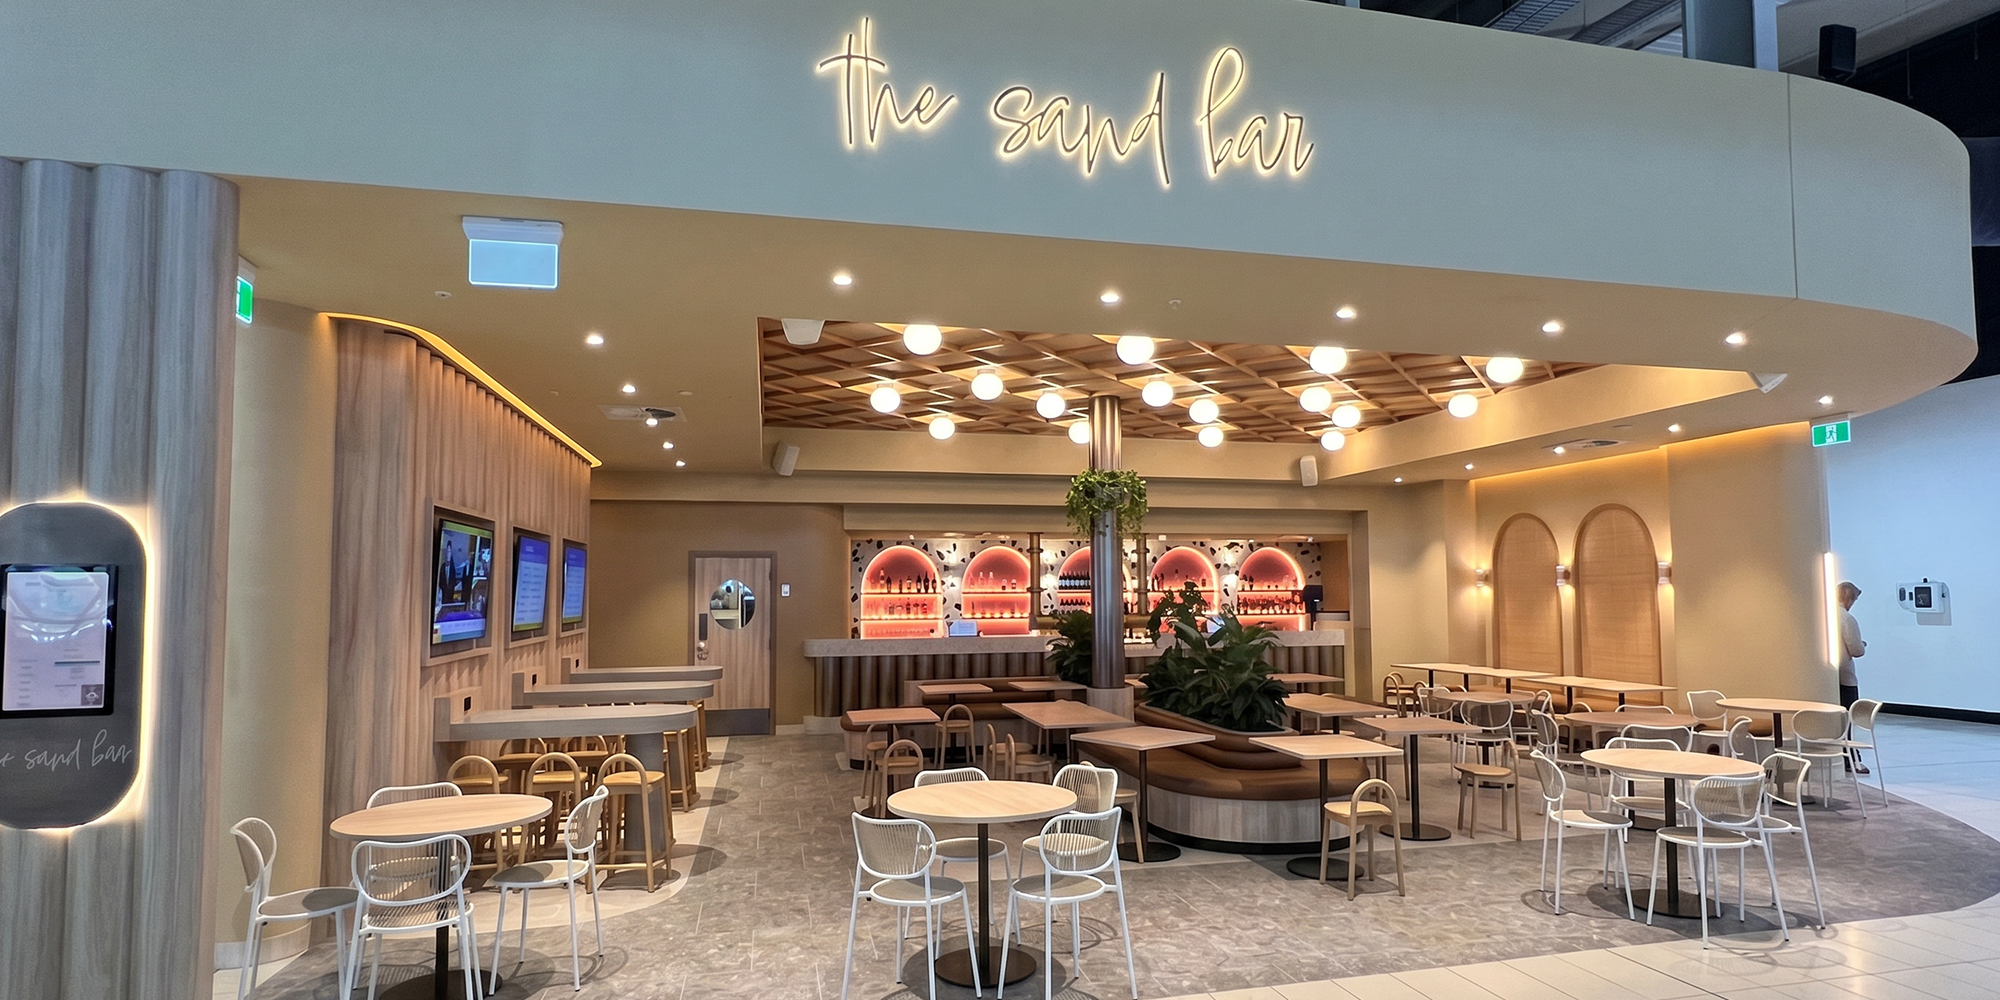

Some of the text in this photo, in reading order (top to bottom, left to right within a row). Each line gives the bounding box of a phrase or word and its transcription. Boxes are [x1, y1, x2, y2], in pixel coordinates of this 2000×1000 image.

[816, 16, 1315, 185] the sand bar
[24, 738, 82, 772] sand
[91, 728, 133, 767] bar
